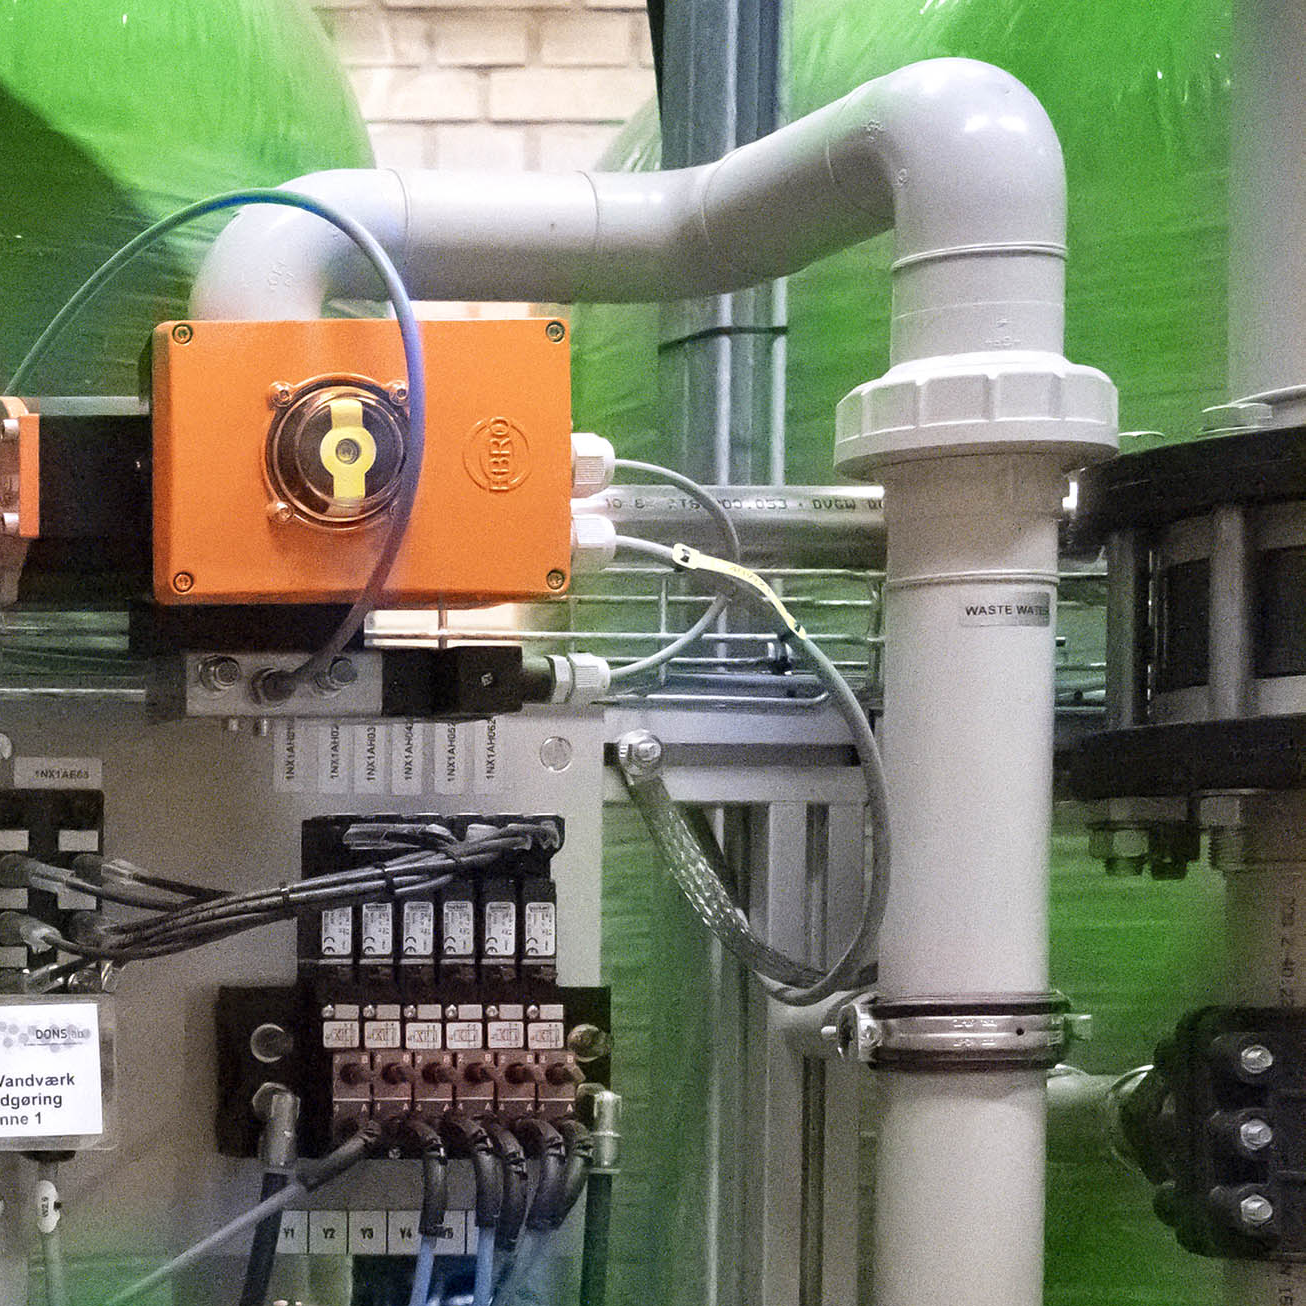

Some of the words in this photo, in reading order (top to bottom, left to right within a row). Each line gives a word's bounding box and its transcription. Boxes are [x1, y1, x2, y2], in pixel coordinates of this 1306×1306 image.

[965, 605, 1012, 616] WASTE
[34, 1112, 42, 1125] 1
[283, 1227, 296, 1240] Y1
[322, 1227, 336, 1240] Y2
[360, 1227, 374, 1240] Y3
[399, 1227, 413, 1240] Y4
